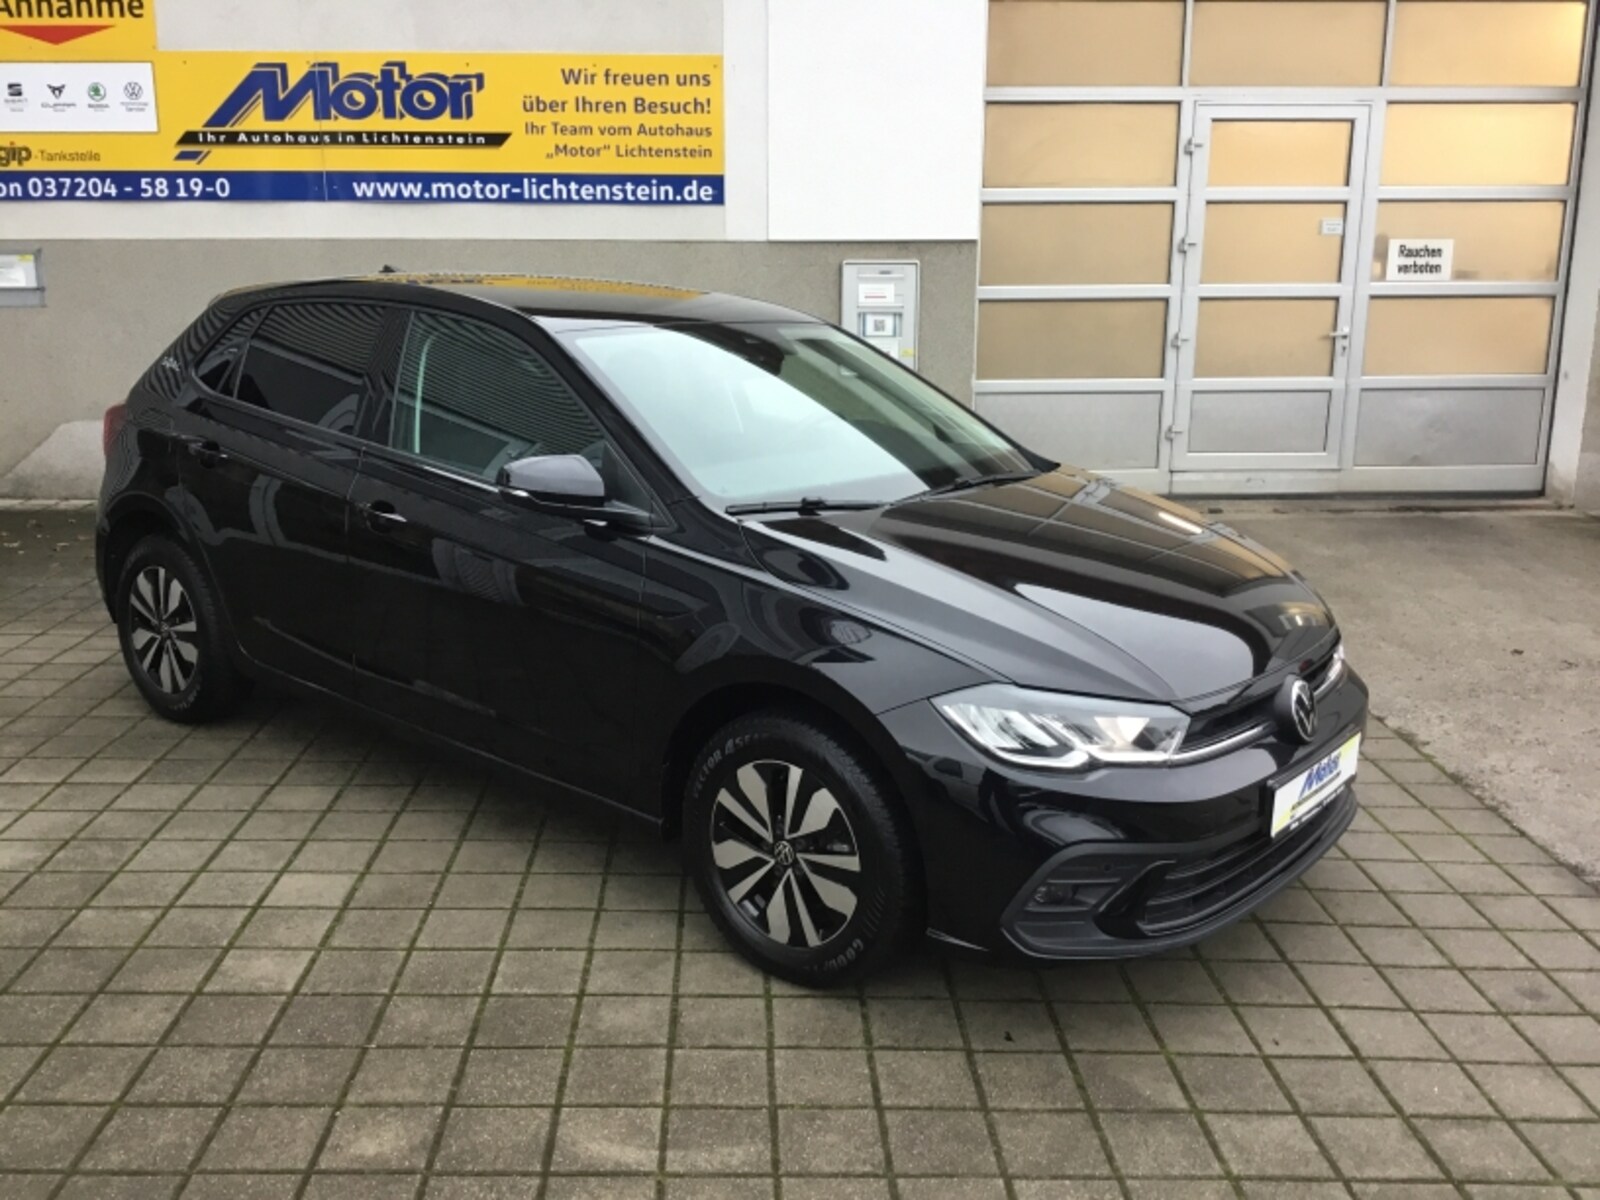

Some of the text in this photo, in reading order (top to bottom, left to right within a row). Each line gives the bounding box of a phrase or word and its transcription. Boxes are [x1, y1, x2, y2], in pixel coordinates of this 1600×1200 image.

[561, 68, 711, 87] Wir freuen uns
[196, 61, 485, 129] Motor
[522, 95, 711, 114] über Ihren Besuch!
[525, 122, 712, 137] Ihr Team vom Autohaus
[198, 132, 486, 145] Ihr Autohaus in Lichtenstein
[616, 145, 712, 158] Lichtenstein
[28, 177, 117, 198] 037204
[140, 178, 169, 197] 58
[176, 178, 230, 197] 19-0
[353, 179, 713, 201] www.motor-lichtenstein.de
[1398, 245, 1443, 258] Rauchen
[1397, 261, 1442, 274] verboten
